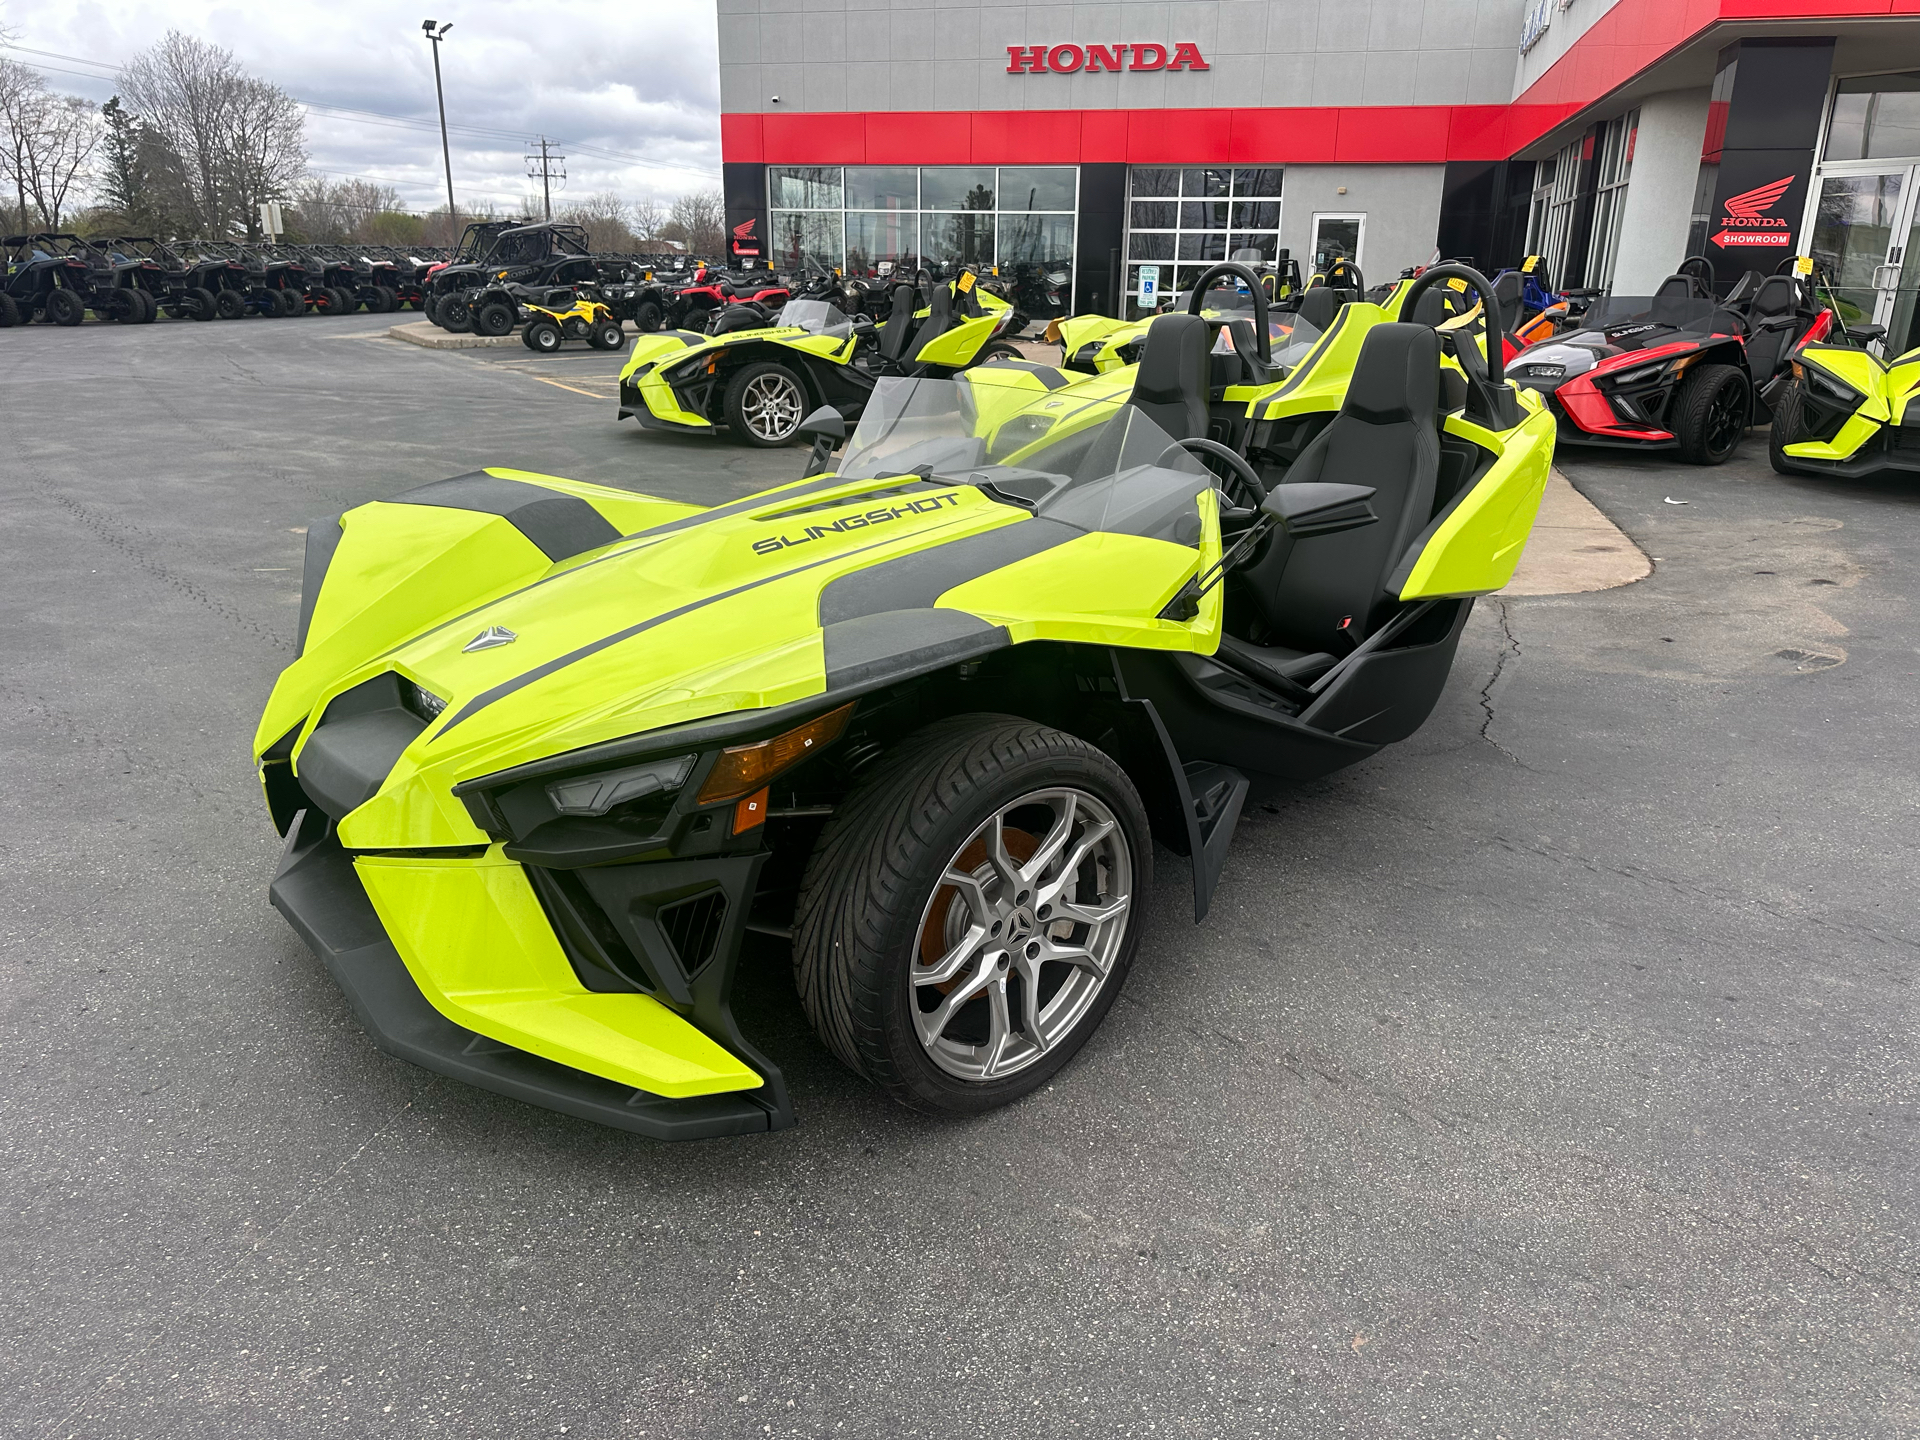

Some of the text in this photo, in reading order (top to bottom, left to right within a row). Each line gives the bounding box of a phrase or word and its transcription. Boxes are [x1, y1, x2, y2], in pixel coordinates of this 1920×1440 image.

[1006, 42, 1210, 73] HONDA
[1720, 217, 1788, 227] HONDA
[1723, 235, 1788, 243] SHOWROOM
[751, 492, 960, 556] SLINGSHOT
